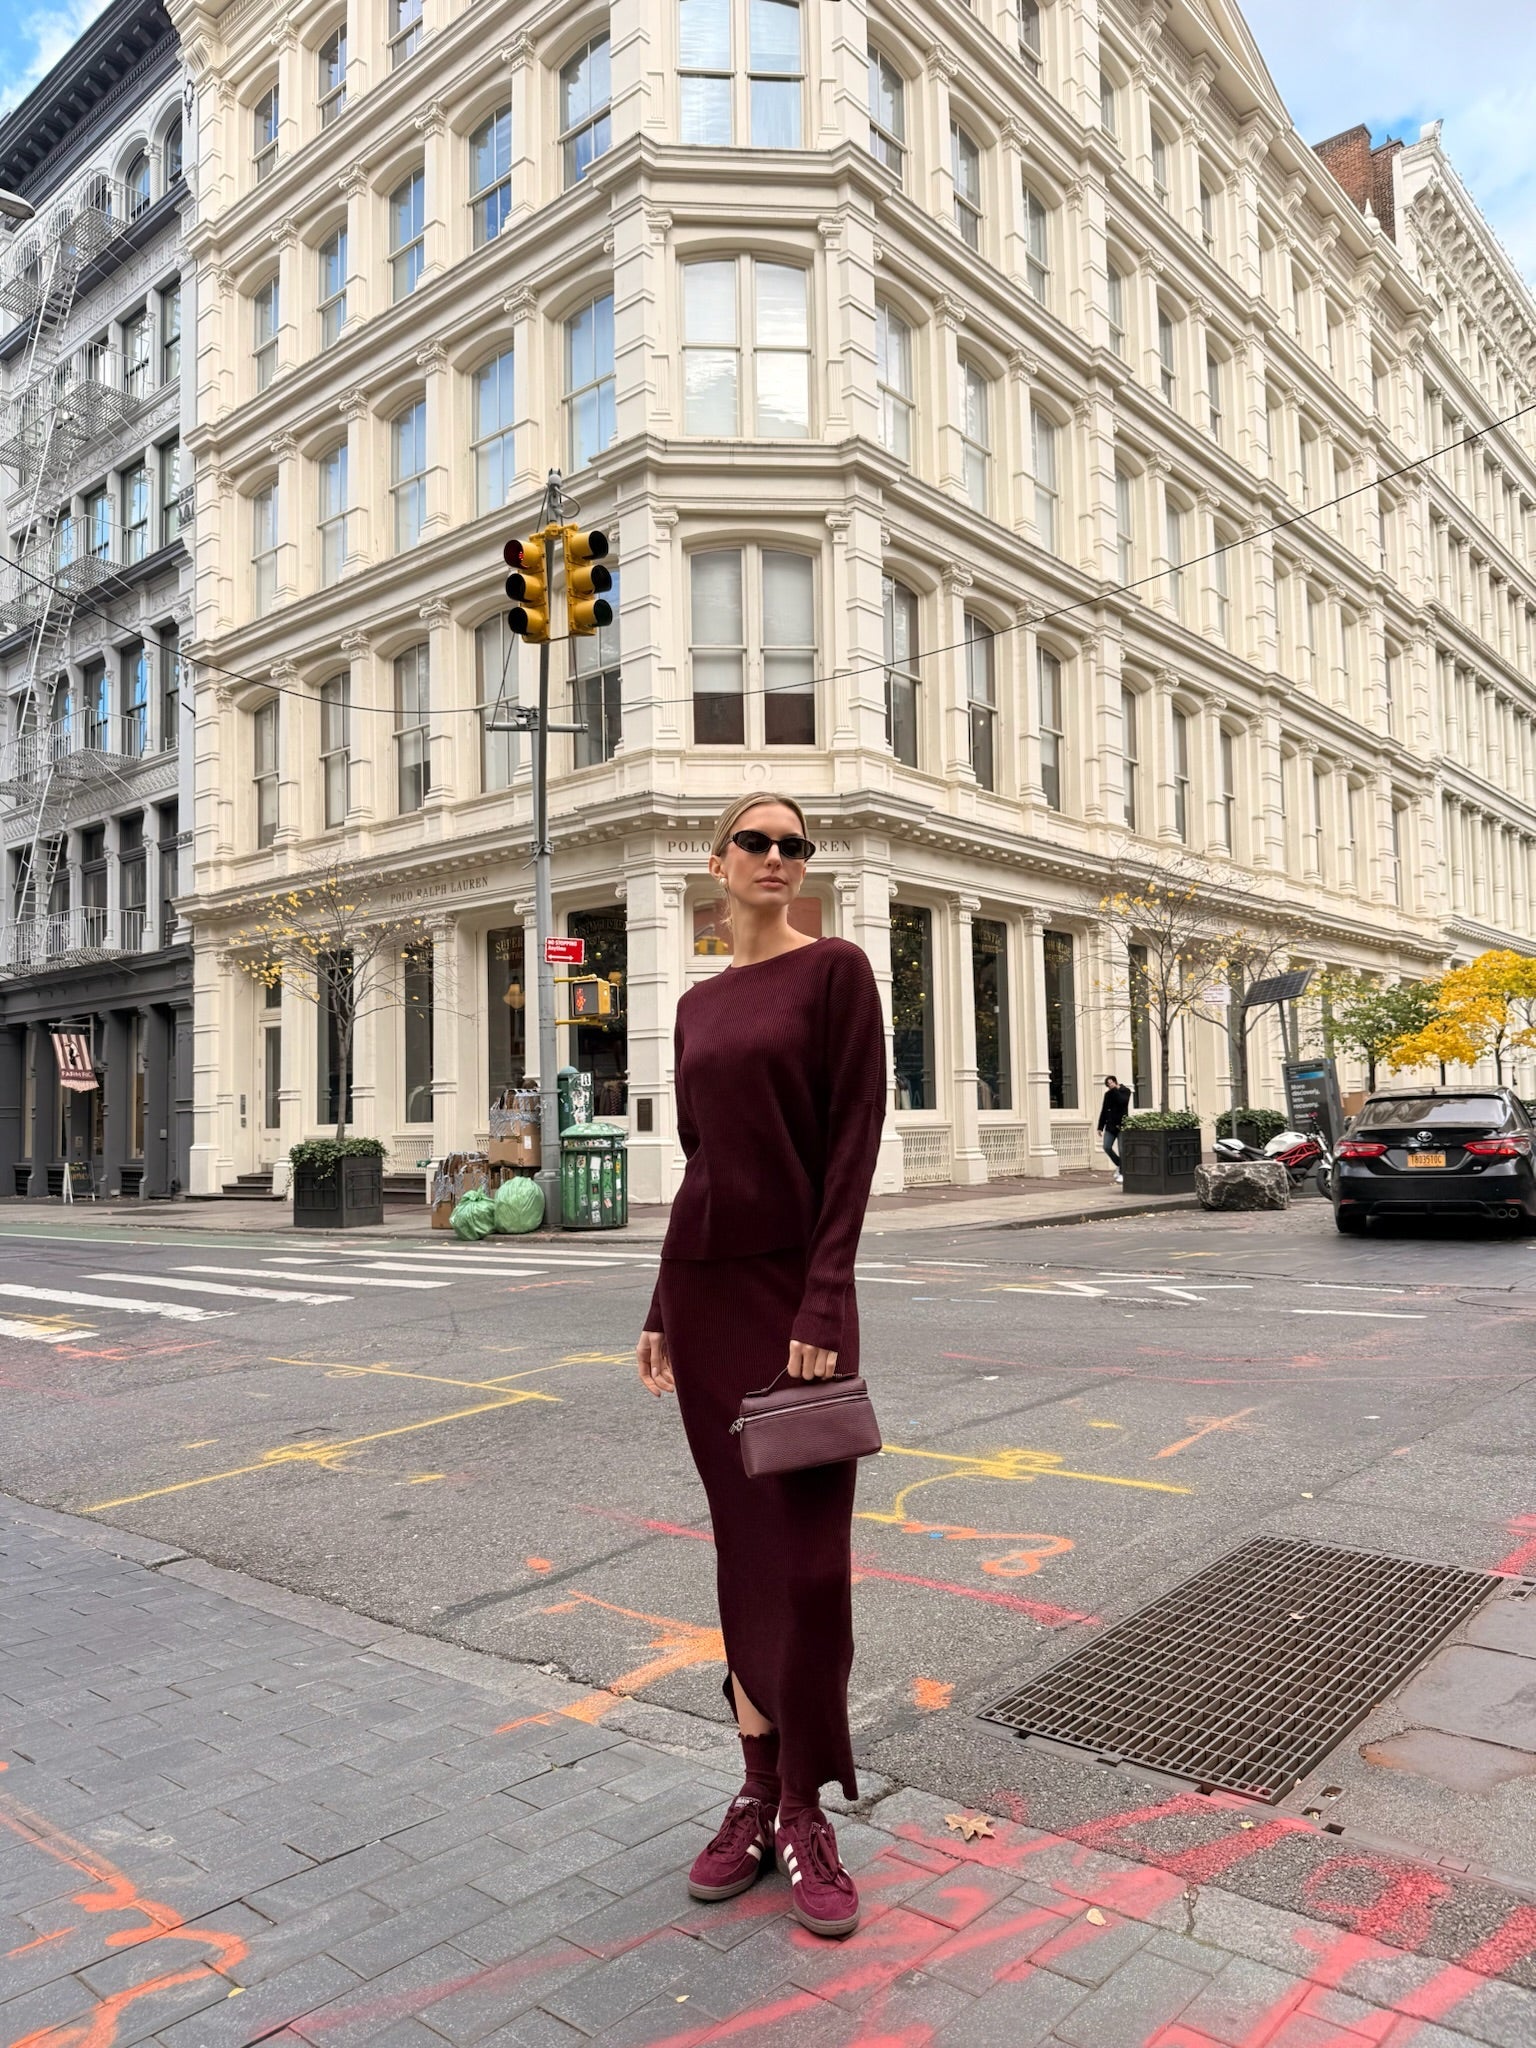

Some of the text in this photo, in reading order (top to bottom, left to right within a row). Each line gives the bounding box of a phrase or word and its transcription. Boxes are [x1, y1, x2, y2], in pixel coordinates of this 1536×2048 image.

[668, 840, 711, 853] POLO
[390, 876, 488, 904] POLO RALPH LAUREN
